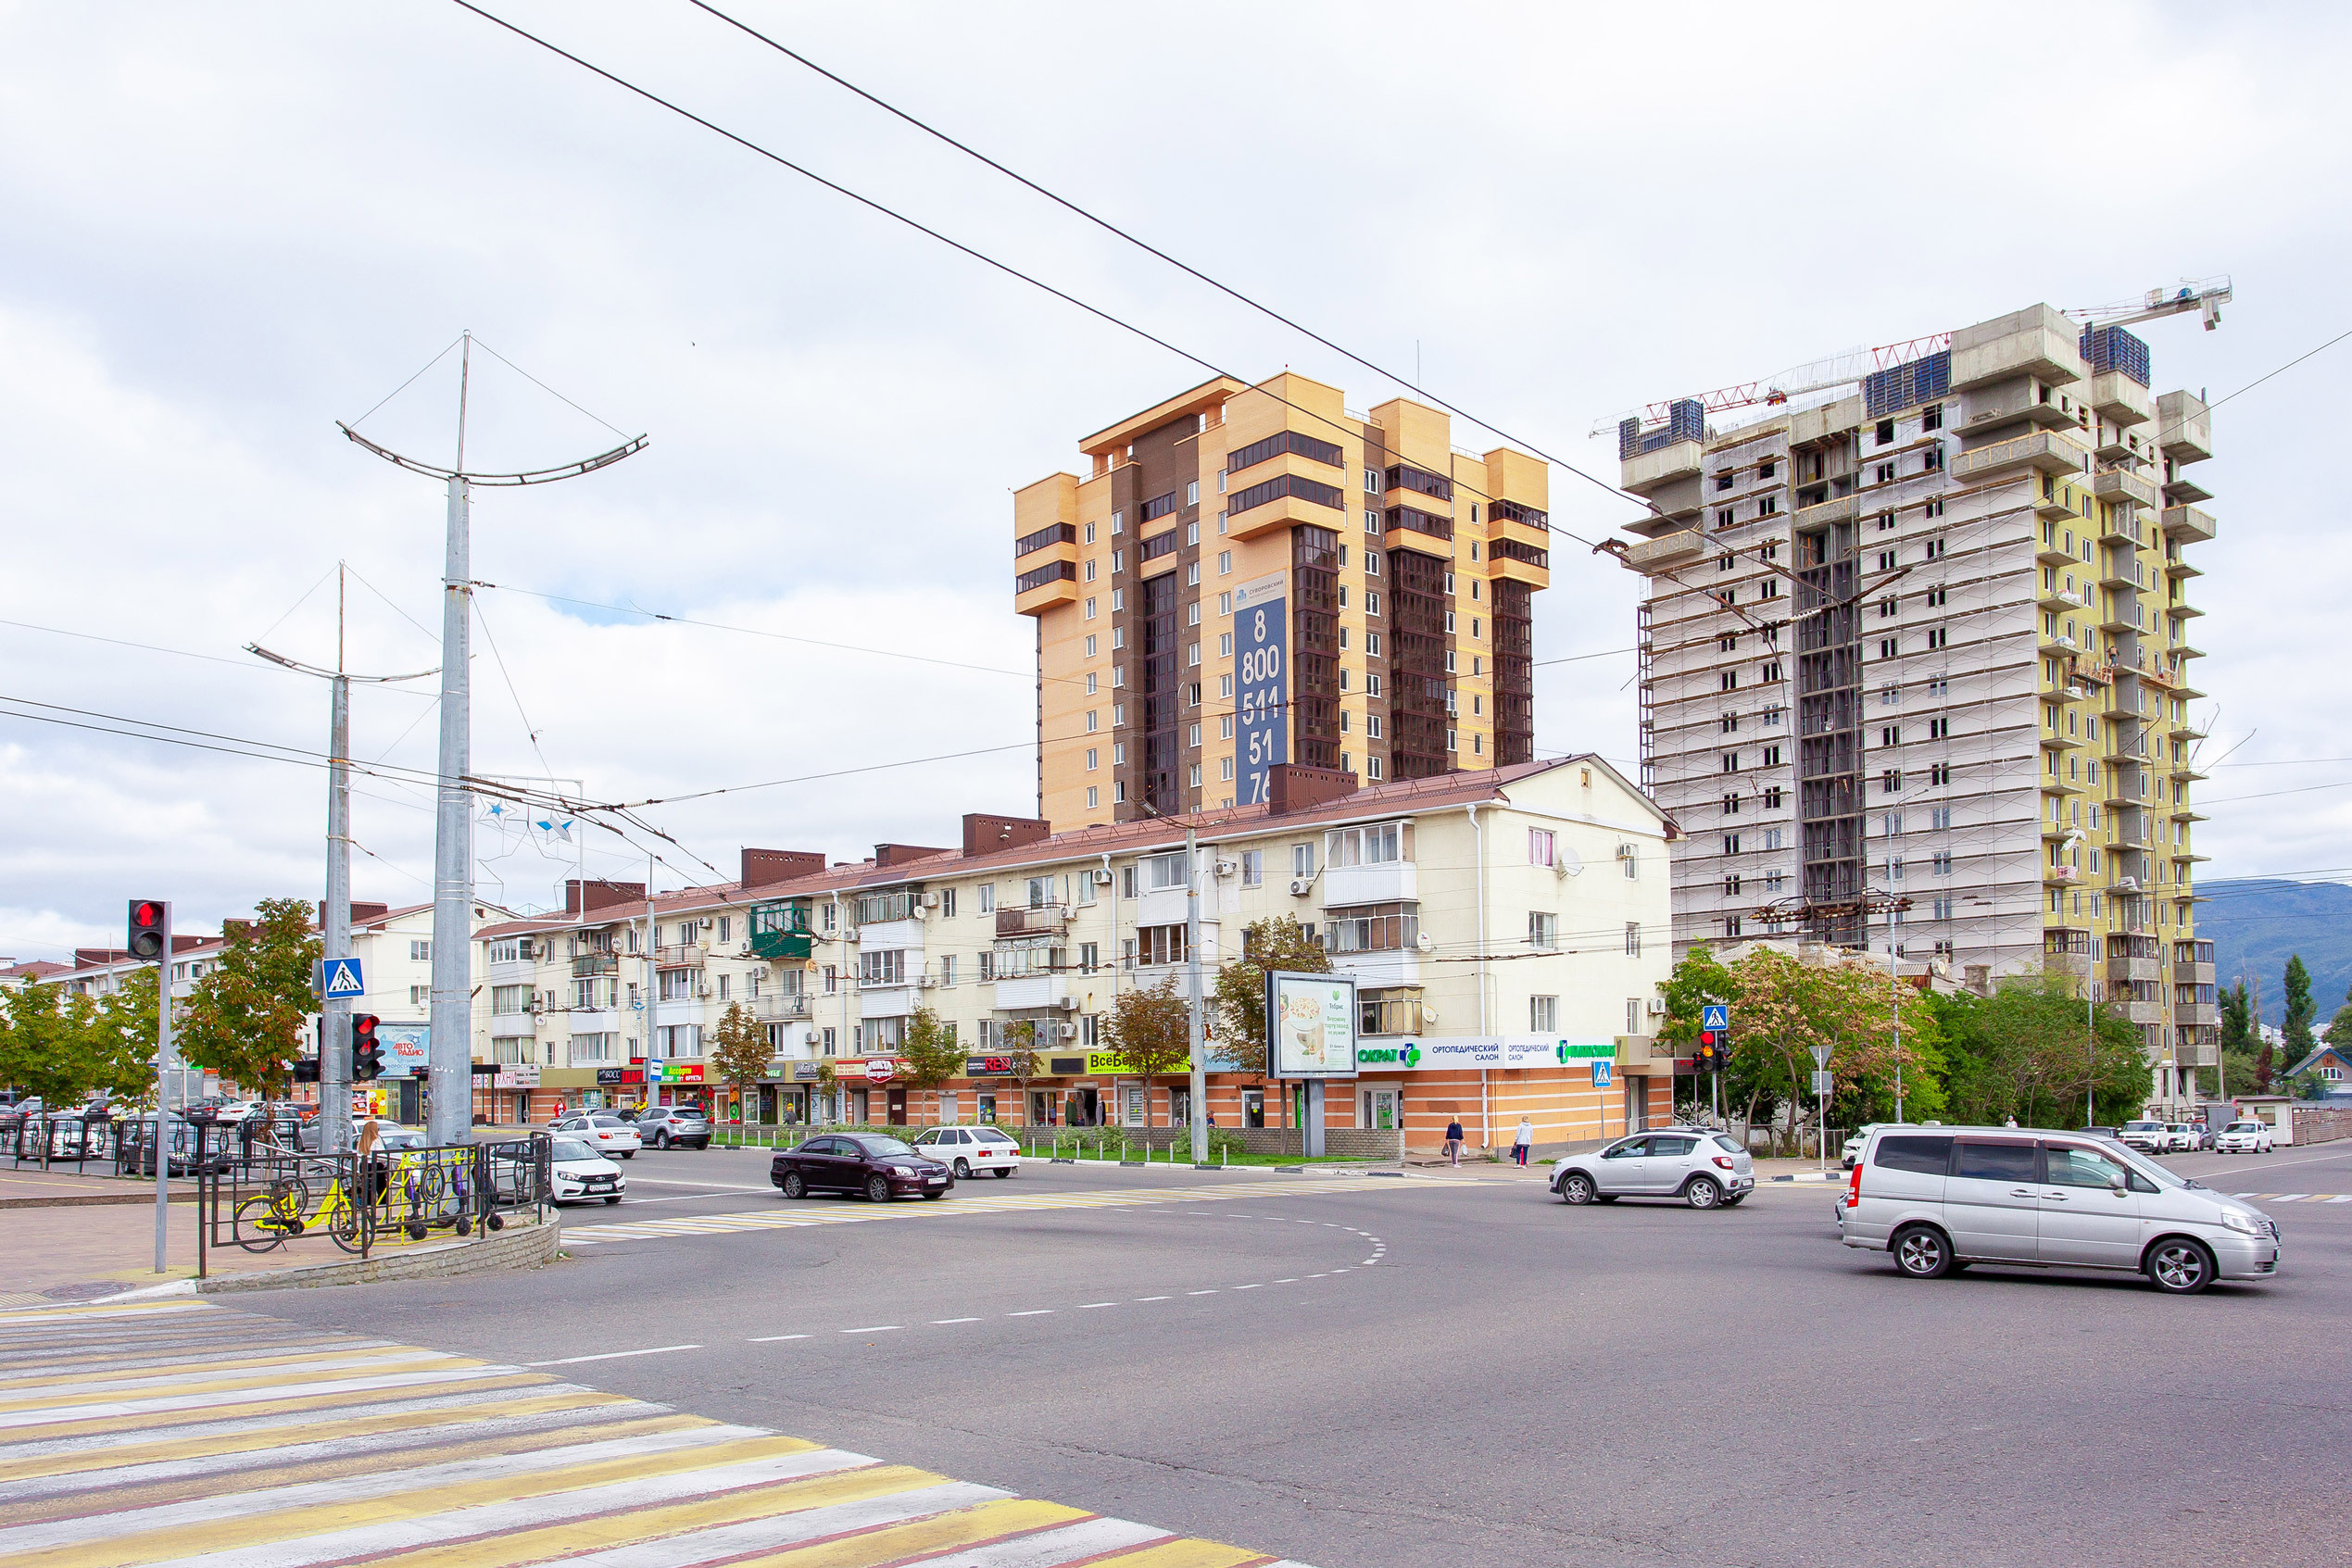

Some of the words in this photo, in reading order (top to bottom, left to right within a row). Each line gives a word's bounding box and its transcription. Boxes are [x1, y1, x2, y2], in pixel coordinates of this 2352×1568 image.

[1249, 579, 1284, 595] СУВОРОВСКИЙ
[1253, 608, 1266, 643] 8
[1242, 645, 1279, 684] 800
[1242, 685, 1278, 725] 511
[1249, 728, 1272, 765] 51
[1432, 1043, 1499, 1054] ОРТОПЕДИЧЕСКИЙ
[1508, 1044, 1549, 1053] ОРТОПЕДИЧЕСКИЙ
[985, 1057, 1011, 1071] RED
[1475, 1053, 1499, 1061] САЛОН
[669, 1066, 692, 1076] Ассорти
